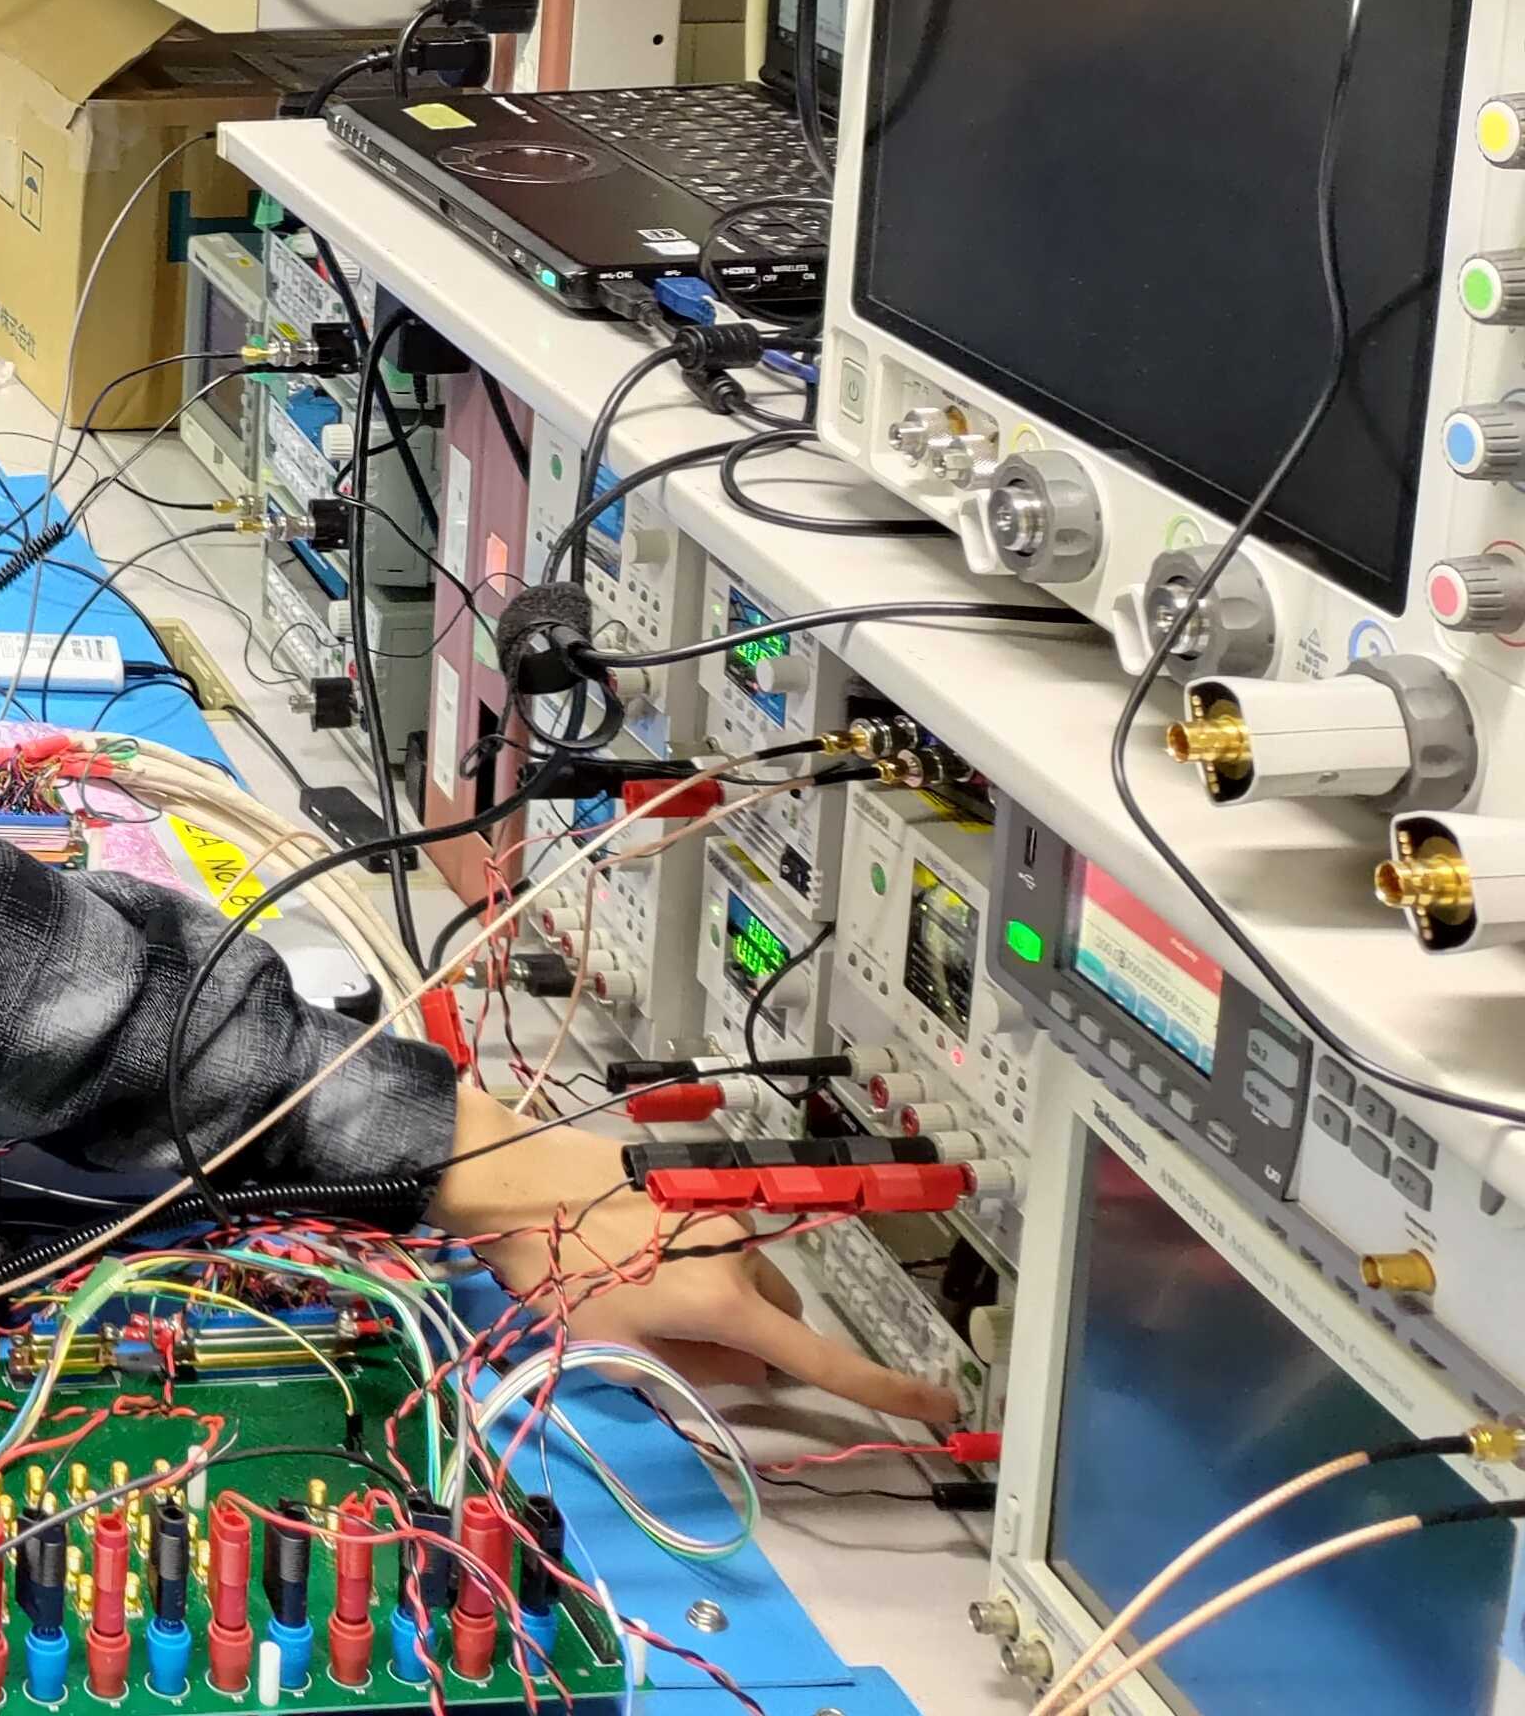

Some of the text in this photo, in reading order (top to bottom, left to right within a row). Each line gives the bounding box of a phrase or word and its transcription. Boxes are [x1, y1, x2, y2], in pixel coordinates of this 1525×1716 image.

[722, 266, 757, 275] HDMI
[762, 274, 778, 282] OFF
[229, 895, 259, 906] 8
[1367, 1103, 1376, 1118] 2
[1092, 1099, 1149, 1166] Tektronix
[1408, 1136, 1416, 1149] 3
[1226, 1235, 1280, 1290] Arbitrary
[1284, 1286, 1346, 1354] Waveform
[1348, 1343, 1415, 1412] Generator
